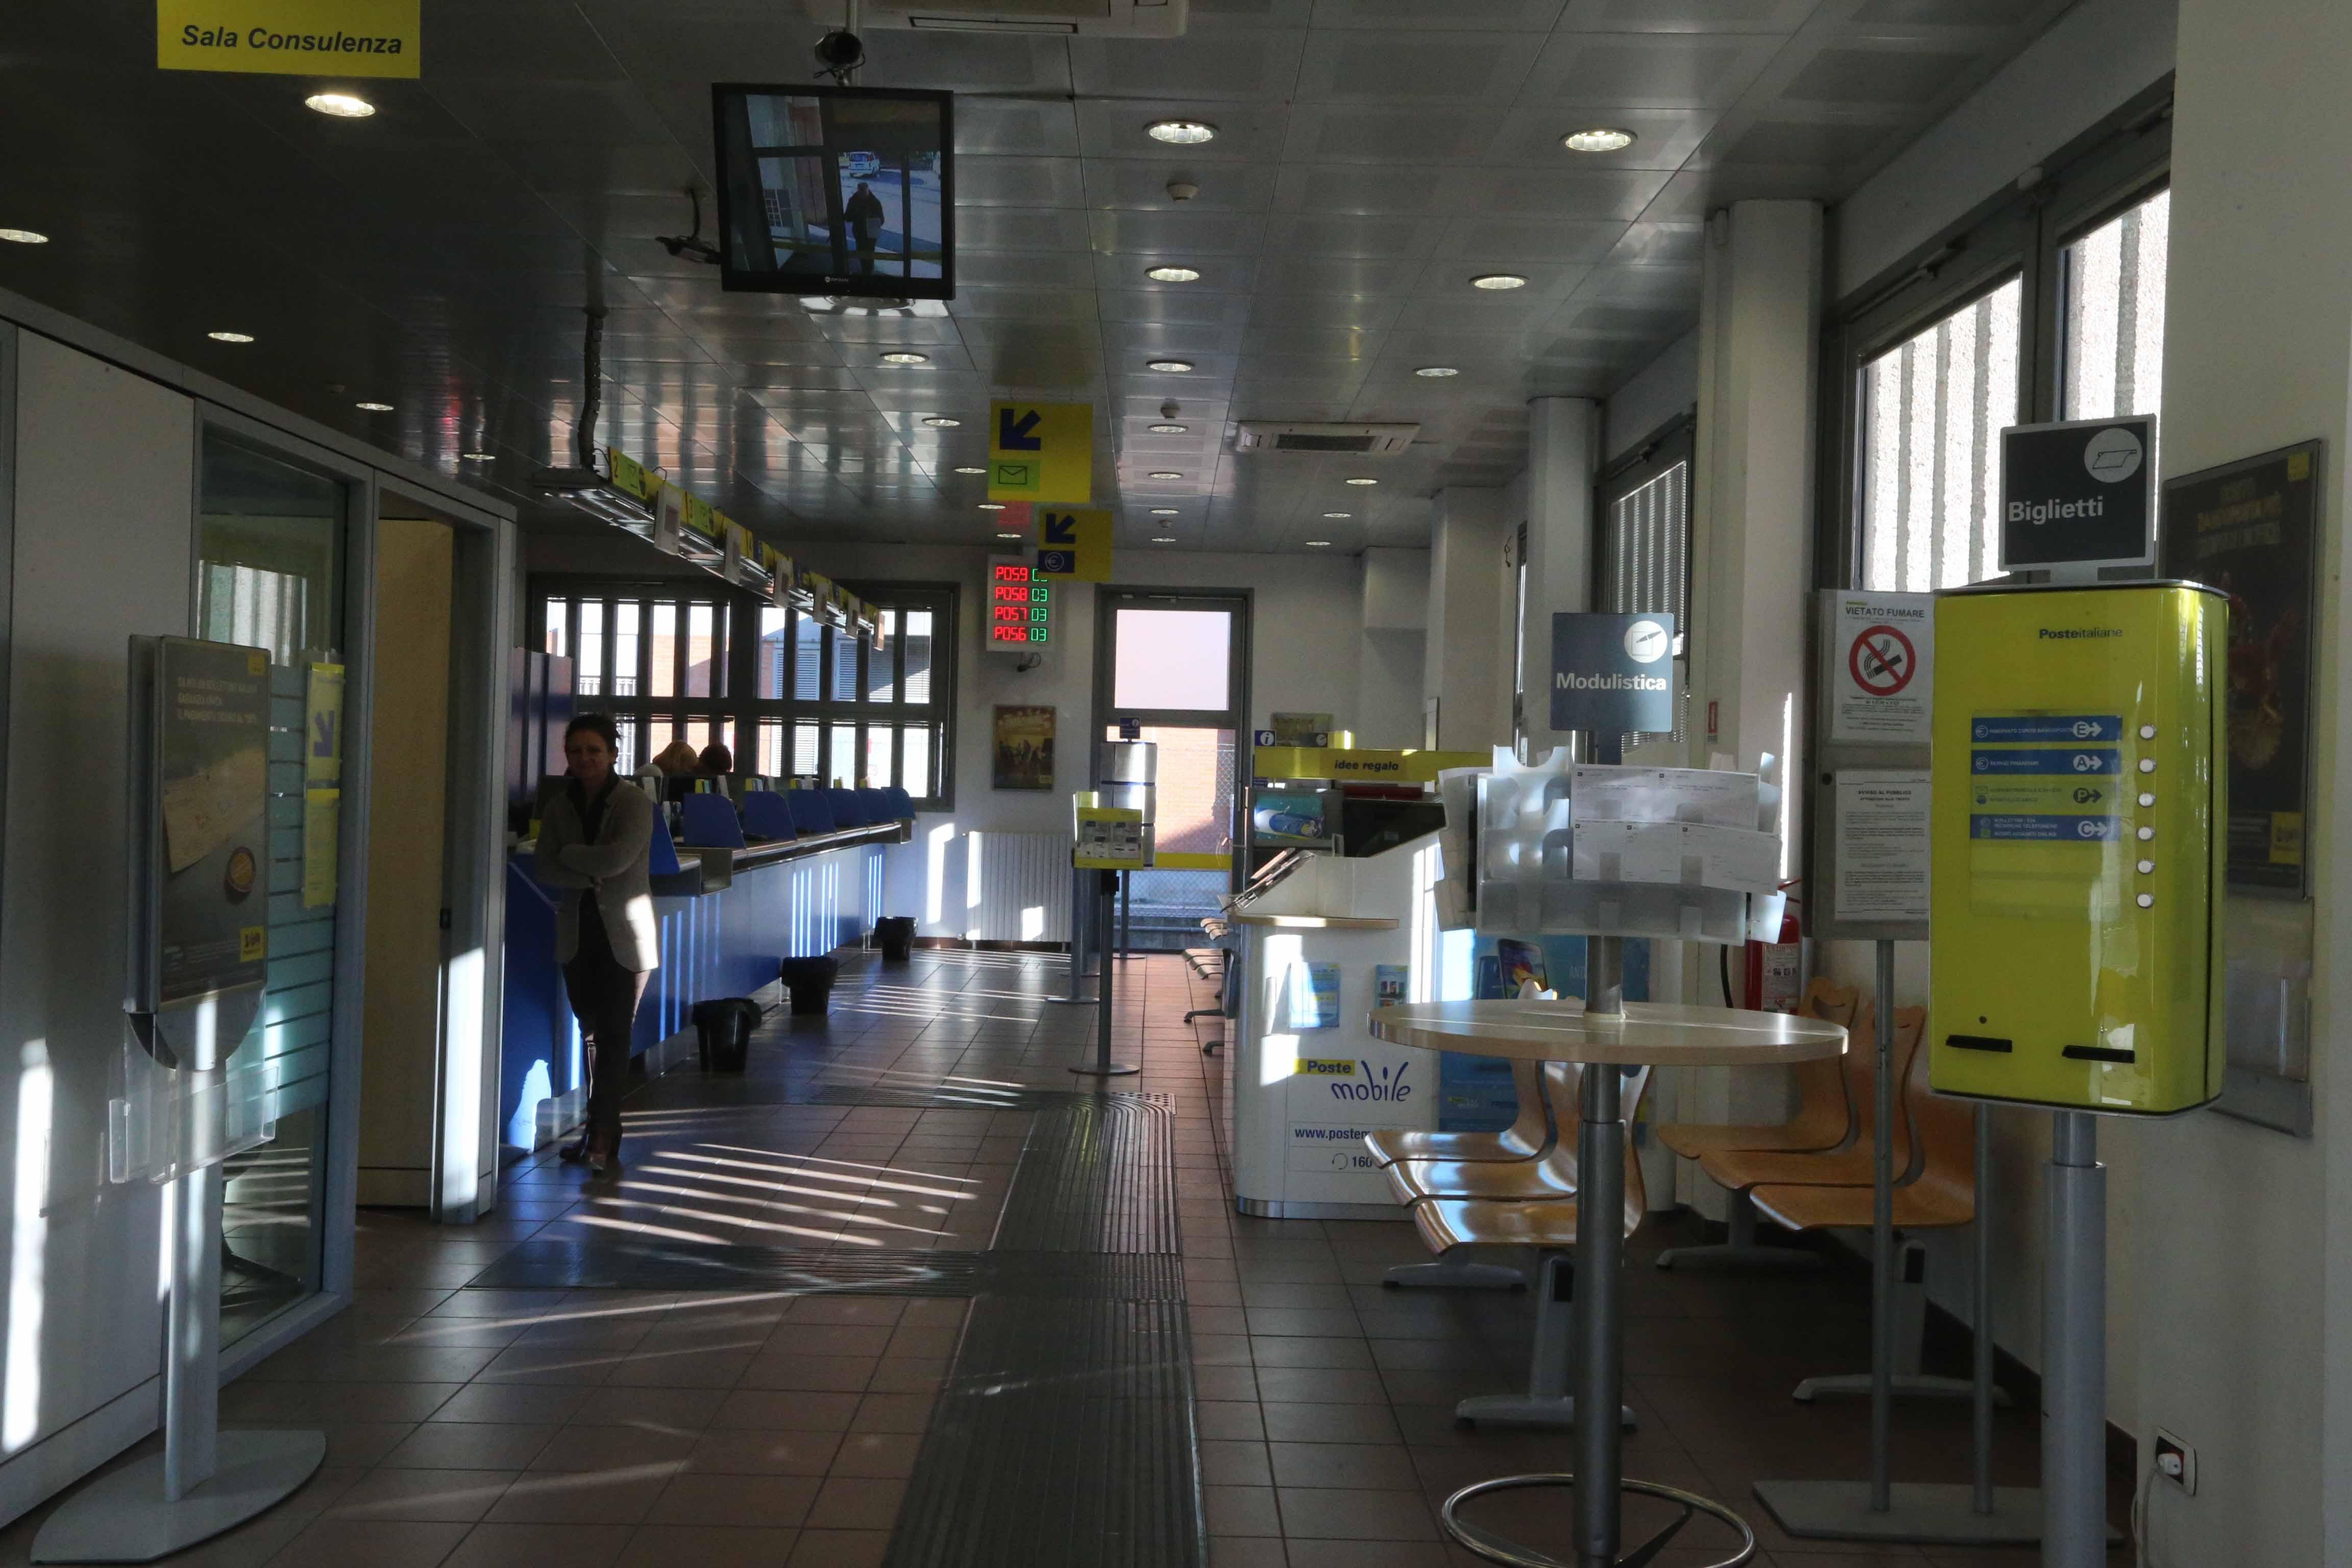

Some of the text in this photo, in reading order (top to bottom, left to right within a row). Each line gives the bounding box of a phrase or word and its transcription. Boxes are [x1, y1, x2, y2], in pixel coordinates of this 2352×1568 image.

[182, 25, 402, 55] Sala Consulenza
[2008, 496, 2103, 525] Biglietti
[996, 566, 1028, 581] P059
[995, 586, 1048, 602] P058 03
[995, 606, 1047, 622] P057 03
[1846, 606, 1925, 618] VIETATO FUMARE
[994, 626, 1046, 642] P056 03
[2039, 627, 2123, 639] Posteitaliane
[1556, 672, 1667, 690] Modulistica
[1335, 760, 1399, 772] idee regalo
[1307, 1060, 1352, 1073] Poste
[1331, 1060, 1411, 1101] mobile
